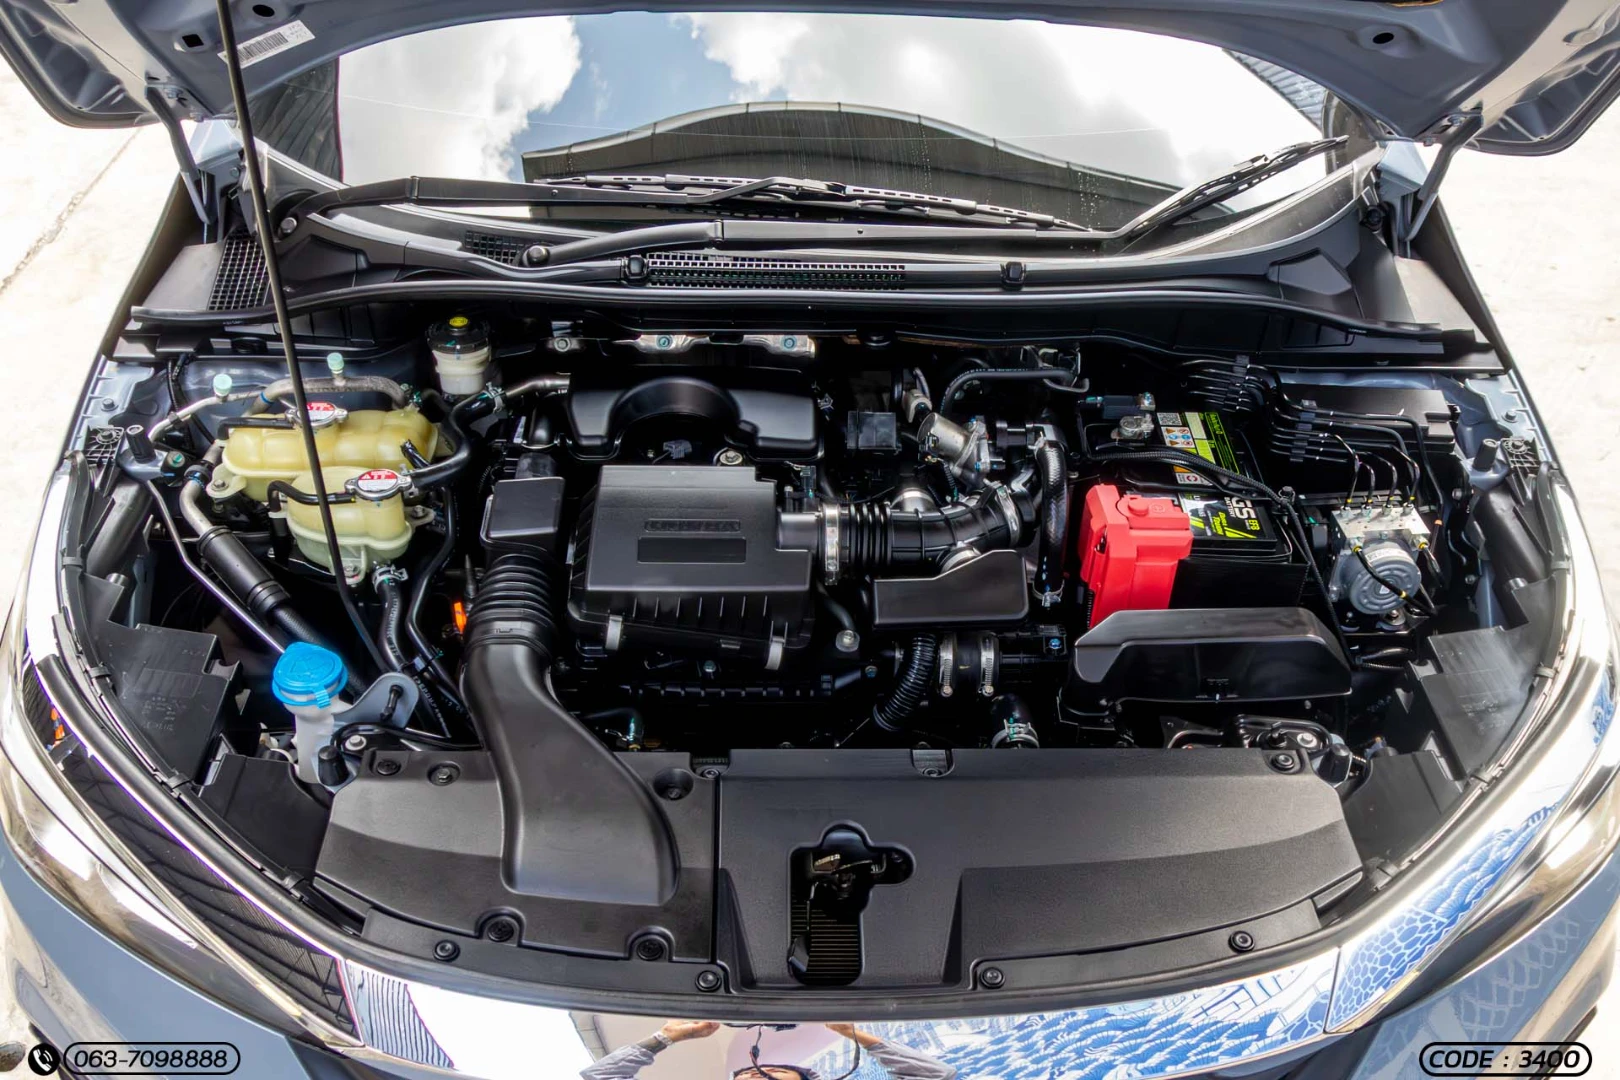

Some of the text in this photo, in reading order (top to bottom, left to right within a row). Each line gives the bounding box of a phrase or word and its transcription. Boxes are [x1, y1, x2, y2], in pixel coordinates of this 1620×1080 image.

[1224, 496, 1237, 518] BATTERY
[1231, 496, 1257, 519] GS
[1248, 519, 1260, 531] EFB
